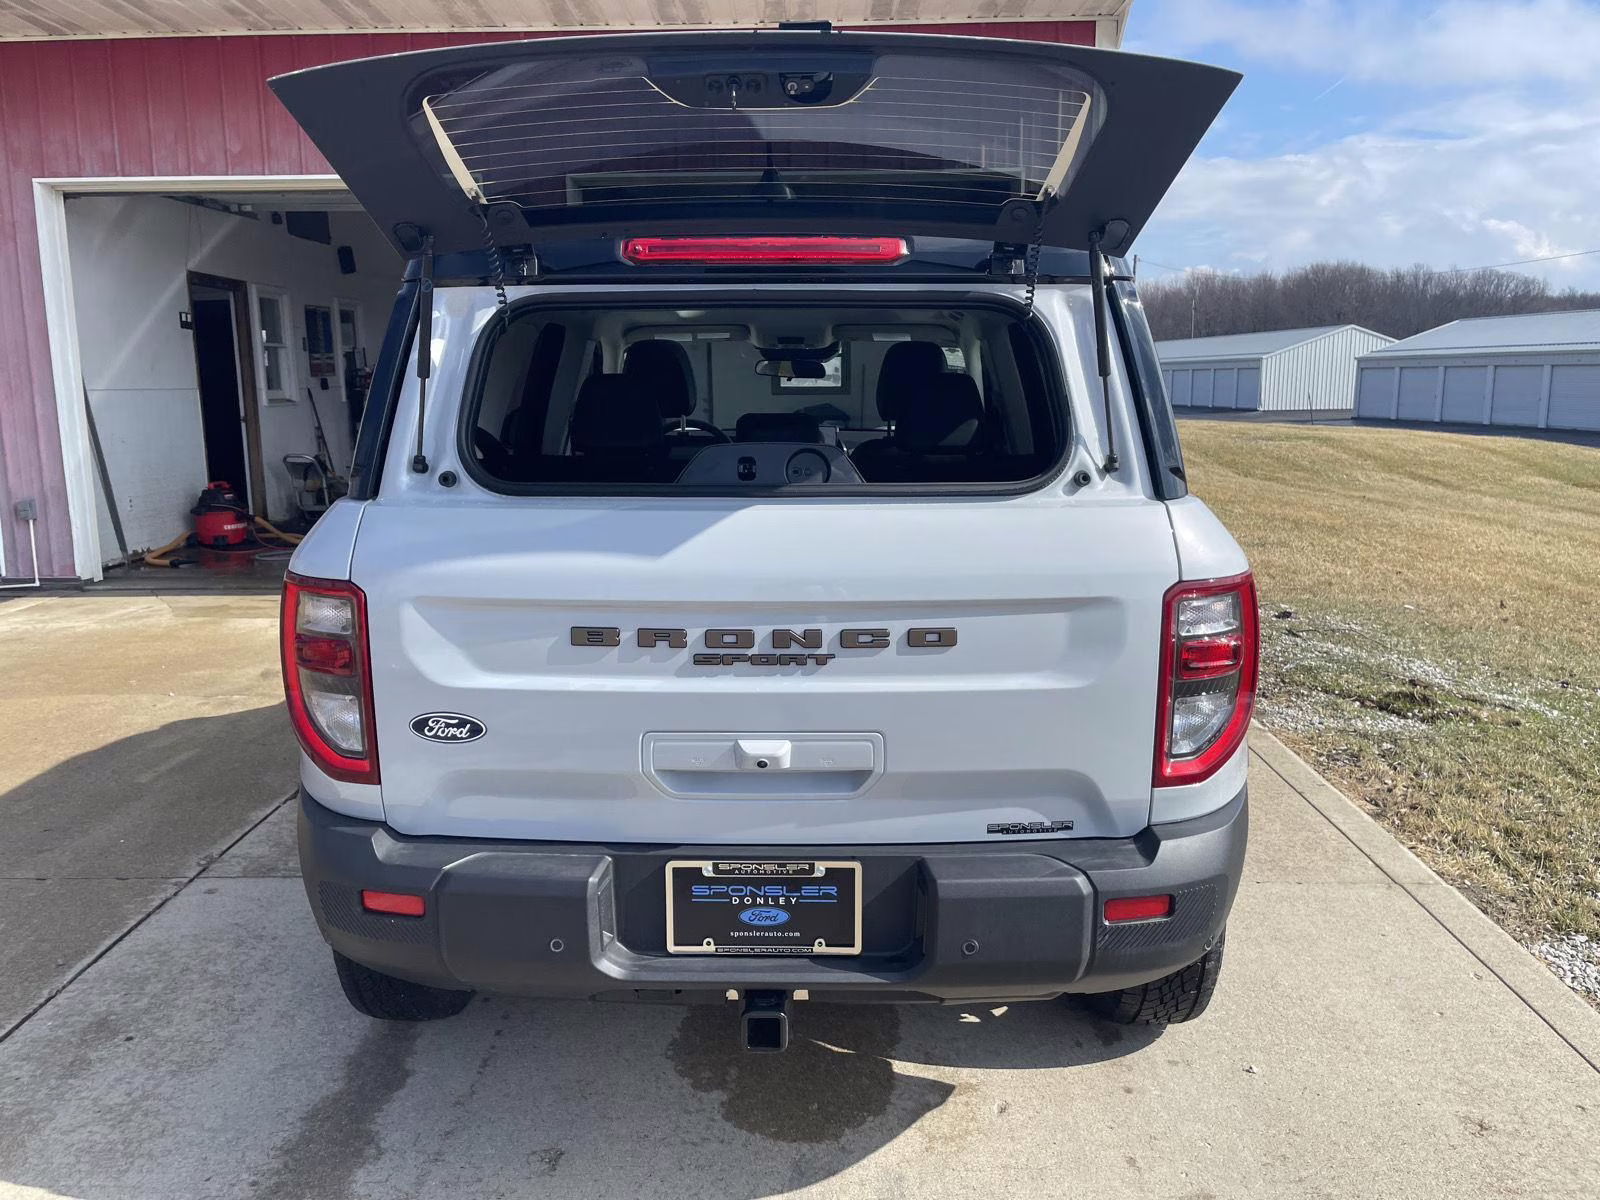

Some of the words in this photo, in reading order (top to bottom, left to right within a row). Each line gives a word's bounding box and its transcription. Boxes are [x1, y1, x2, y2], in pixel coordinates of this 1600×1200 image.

[570, 626, 958, 649] BRONCO
[693, 653, 836, 666] SPORT
[424, 717, 471, 738] Ford
[987, 820, 1074, 831] SPONSLER
[718, 863, 810, 871] SPONSLER
[691, 885, 838, 897] SPONSLER
[732, 896, 798, 905] DONLEY
[747, 909, 780, 923] Ford
[730, 930, 801, 938] sponslerauto.com
